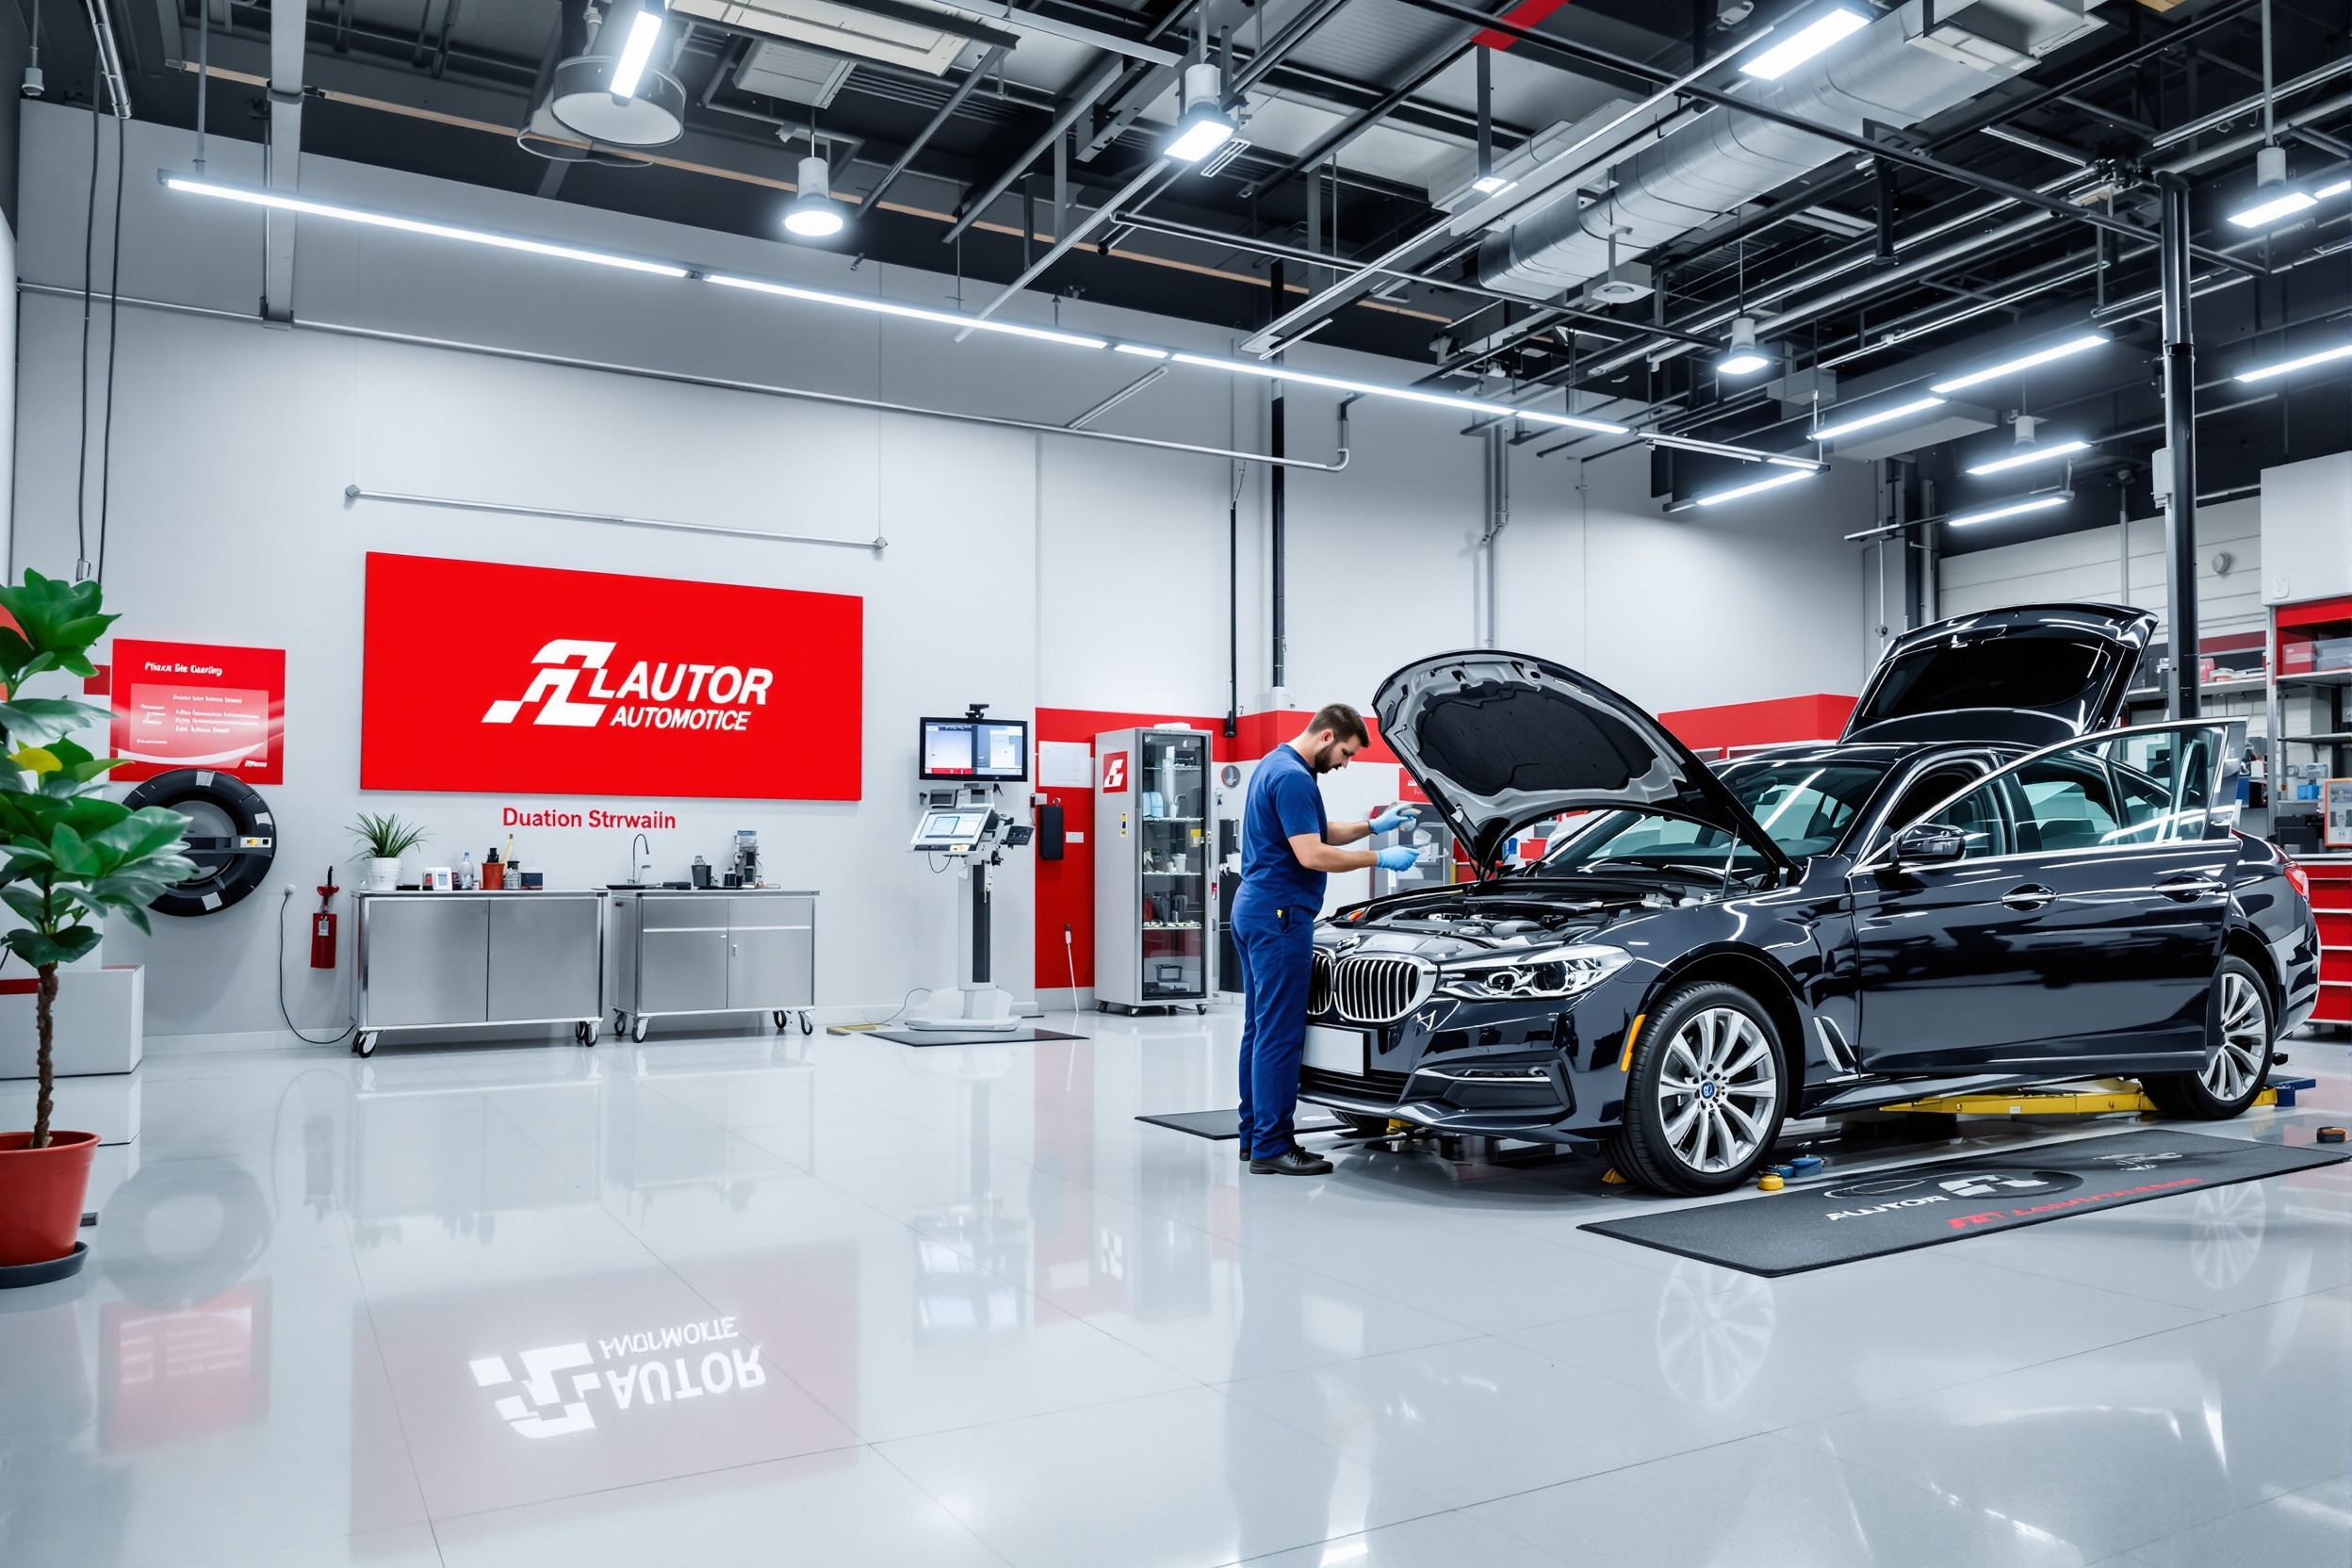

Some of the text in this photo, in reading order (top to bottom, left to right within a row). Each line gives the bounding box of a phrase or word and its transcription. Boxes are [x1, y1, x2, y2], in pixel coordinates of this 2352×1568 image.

[615, 661, 774, 705] AUTOR
[610, 706, 751, 731] AUTOMOTICE
[502, 807, 582, 827] Duation
